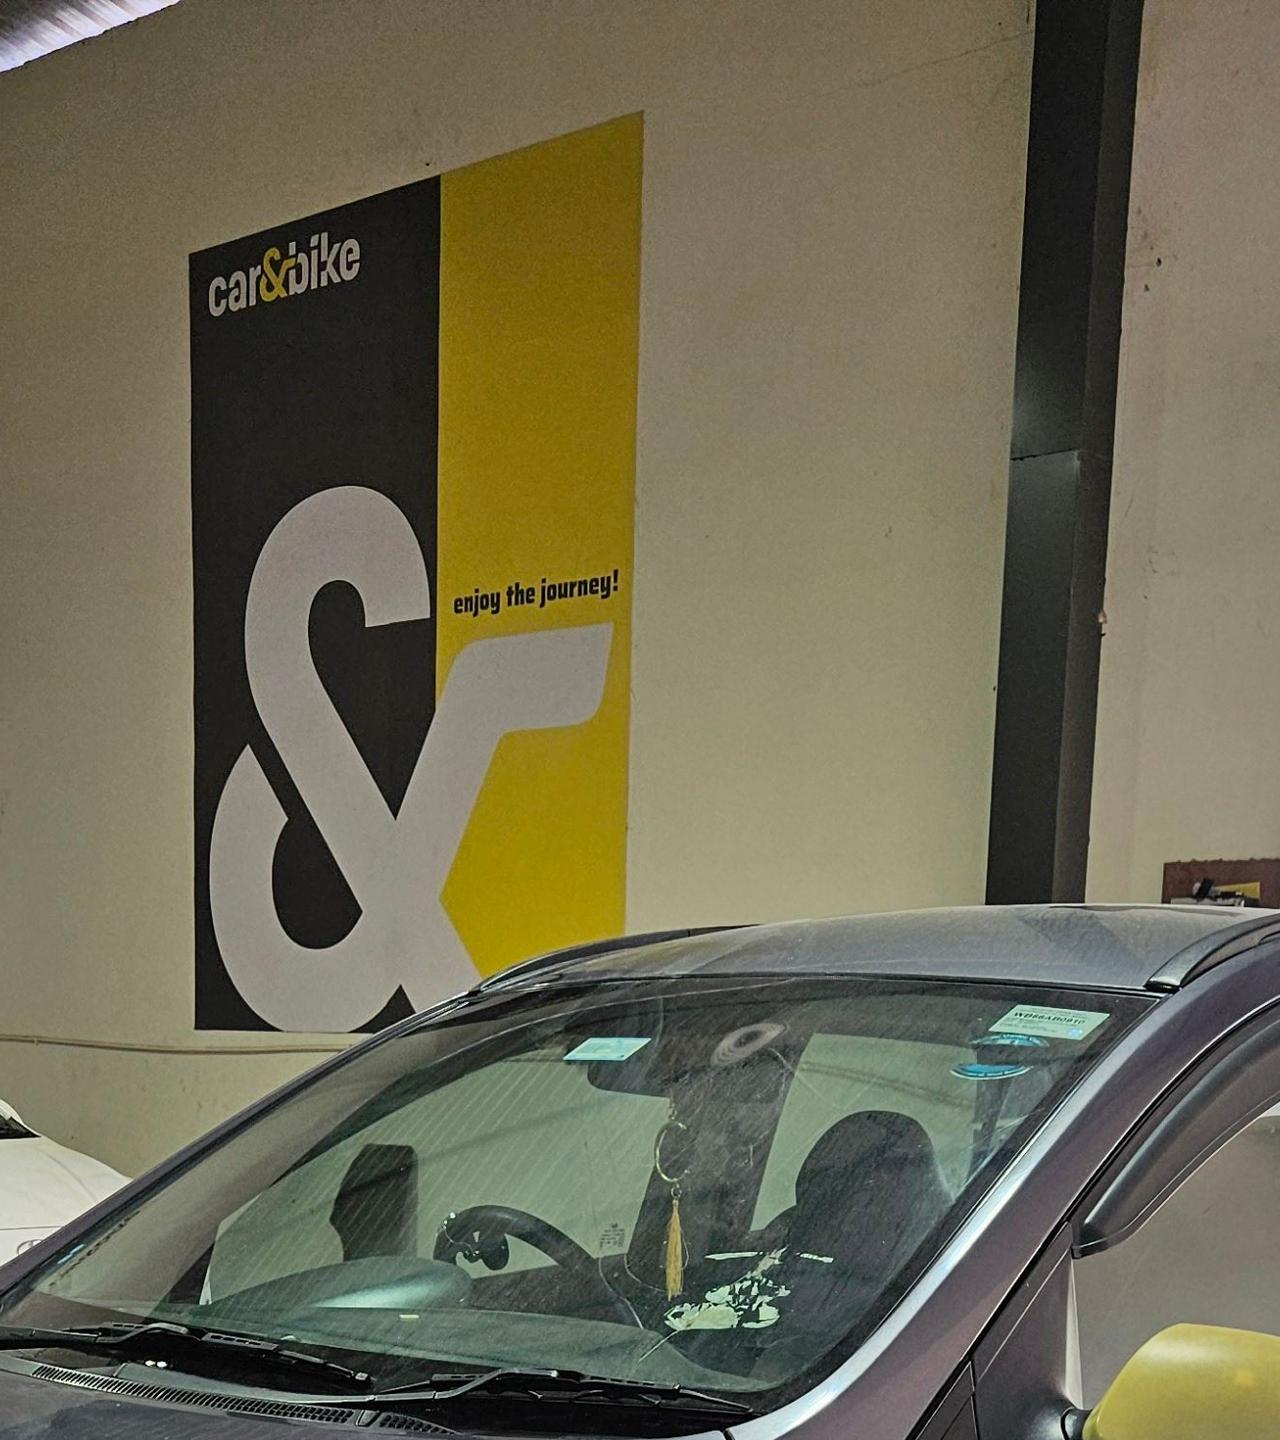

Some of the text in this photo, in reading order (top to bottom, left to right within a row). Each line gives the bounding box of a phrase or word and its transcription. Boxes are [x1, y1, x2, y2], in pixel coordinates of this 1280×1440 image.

[208, 232, 360, 317] car&bike
[454, 569, 619, 617] enjoy the journey!
